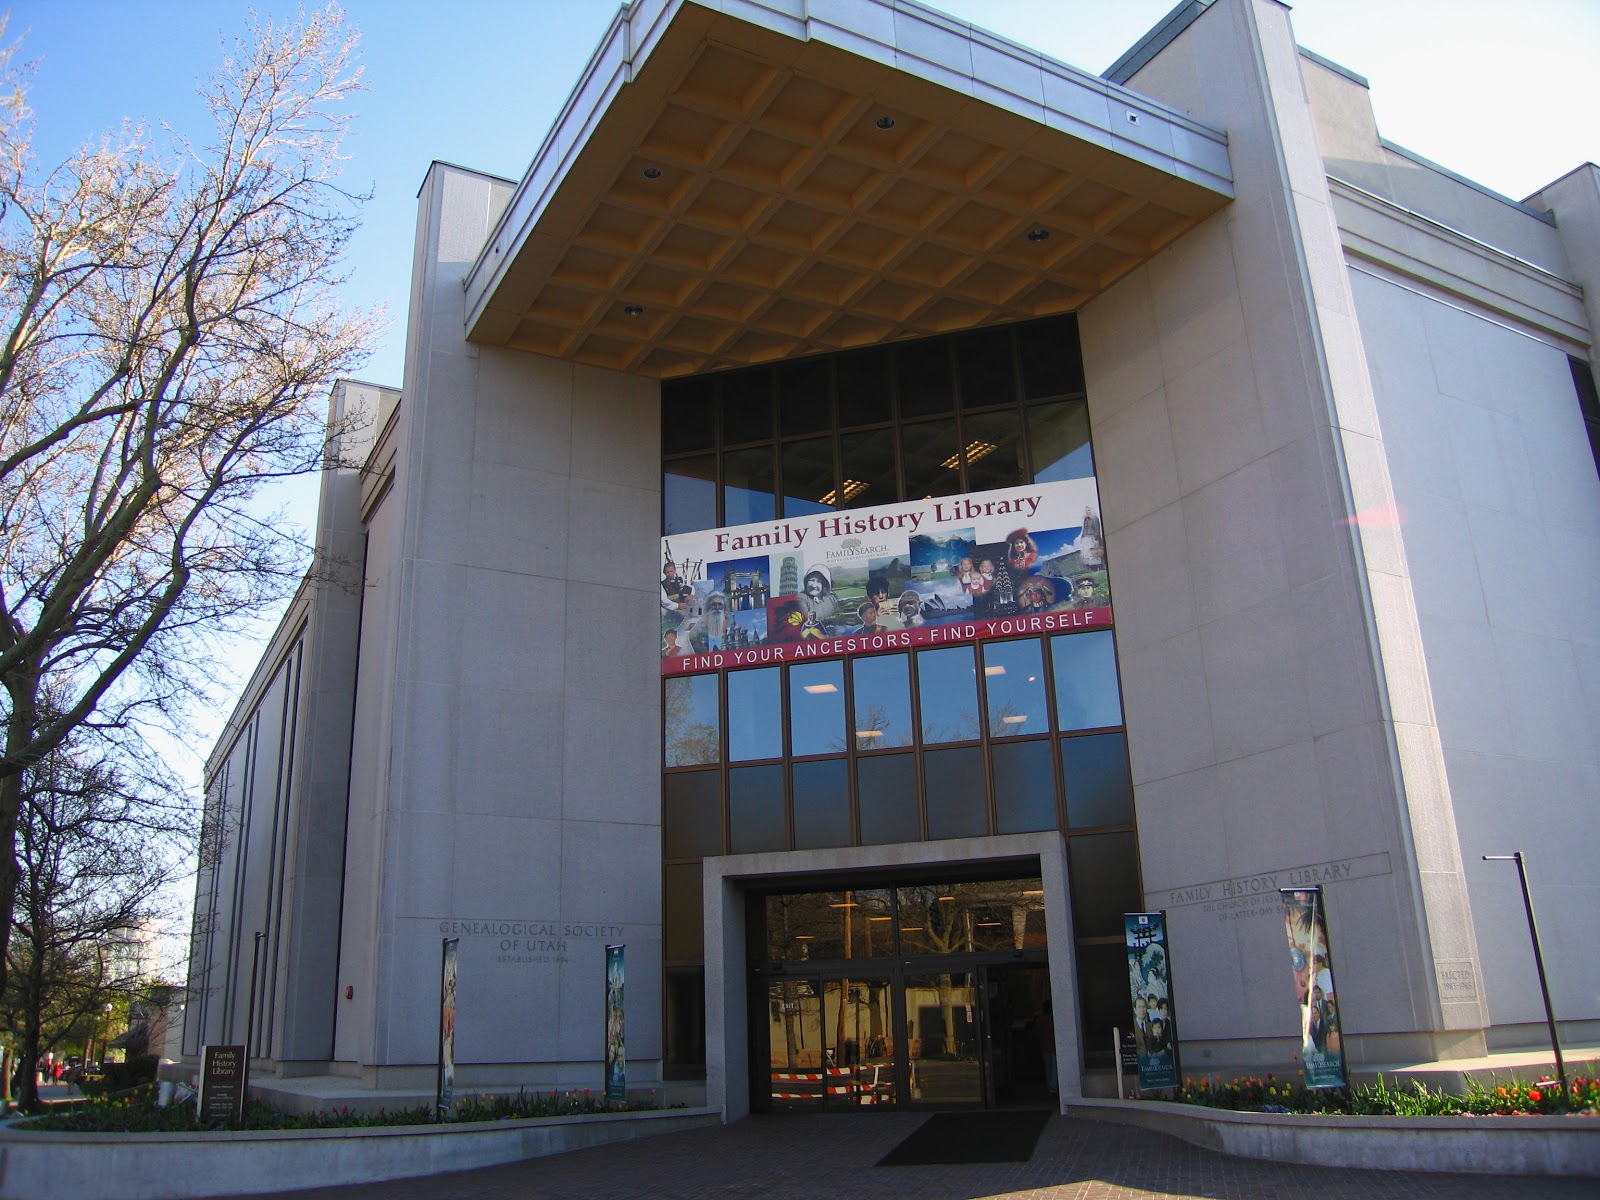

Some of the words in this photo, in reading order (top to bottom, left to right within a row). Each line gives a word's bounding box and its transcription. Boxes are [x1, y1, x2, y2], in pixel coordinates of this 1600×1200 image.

[714, 523, 810, 553] Family
[818, 511, 925, 539] History
[934, 495, 1043, 523] Library
[826, 545, 887, 558] FAMILYSEARCH
[682, 655, 725, 671] FIND
[734, 647, 785, 665] YOUR
[794, 634, 911, 657] ANCESTORS
[930, 626, 976, 642] FIND
[986, 612, 1095, 635] YOURSELF
[1170, 887, 1212, 904] FAMILY
[1223, 875, 1278, 897] HISTORY
[1290, 863, 1352, 885] LIBRARY
[1217, 900, 1248, 911] CHURCH
[1262, 894, 1281, 904] JESU
[439, 921, 556, 936] GENEALOGICAL
[564, 925, 625, 937] SOCIETY
[500, 939, 519, 951] OF
[527, 940, 567, 952] UTAH
[497, 955, 549, 963] ESTABLISHED
[214, 1051, 236, 1060] Family
[212, 1060, 237, 1068] History
[212, 1067, 236, 1076] Library
